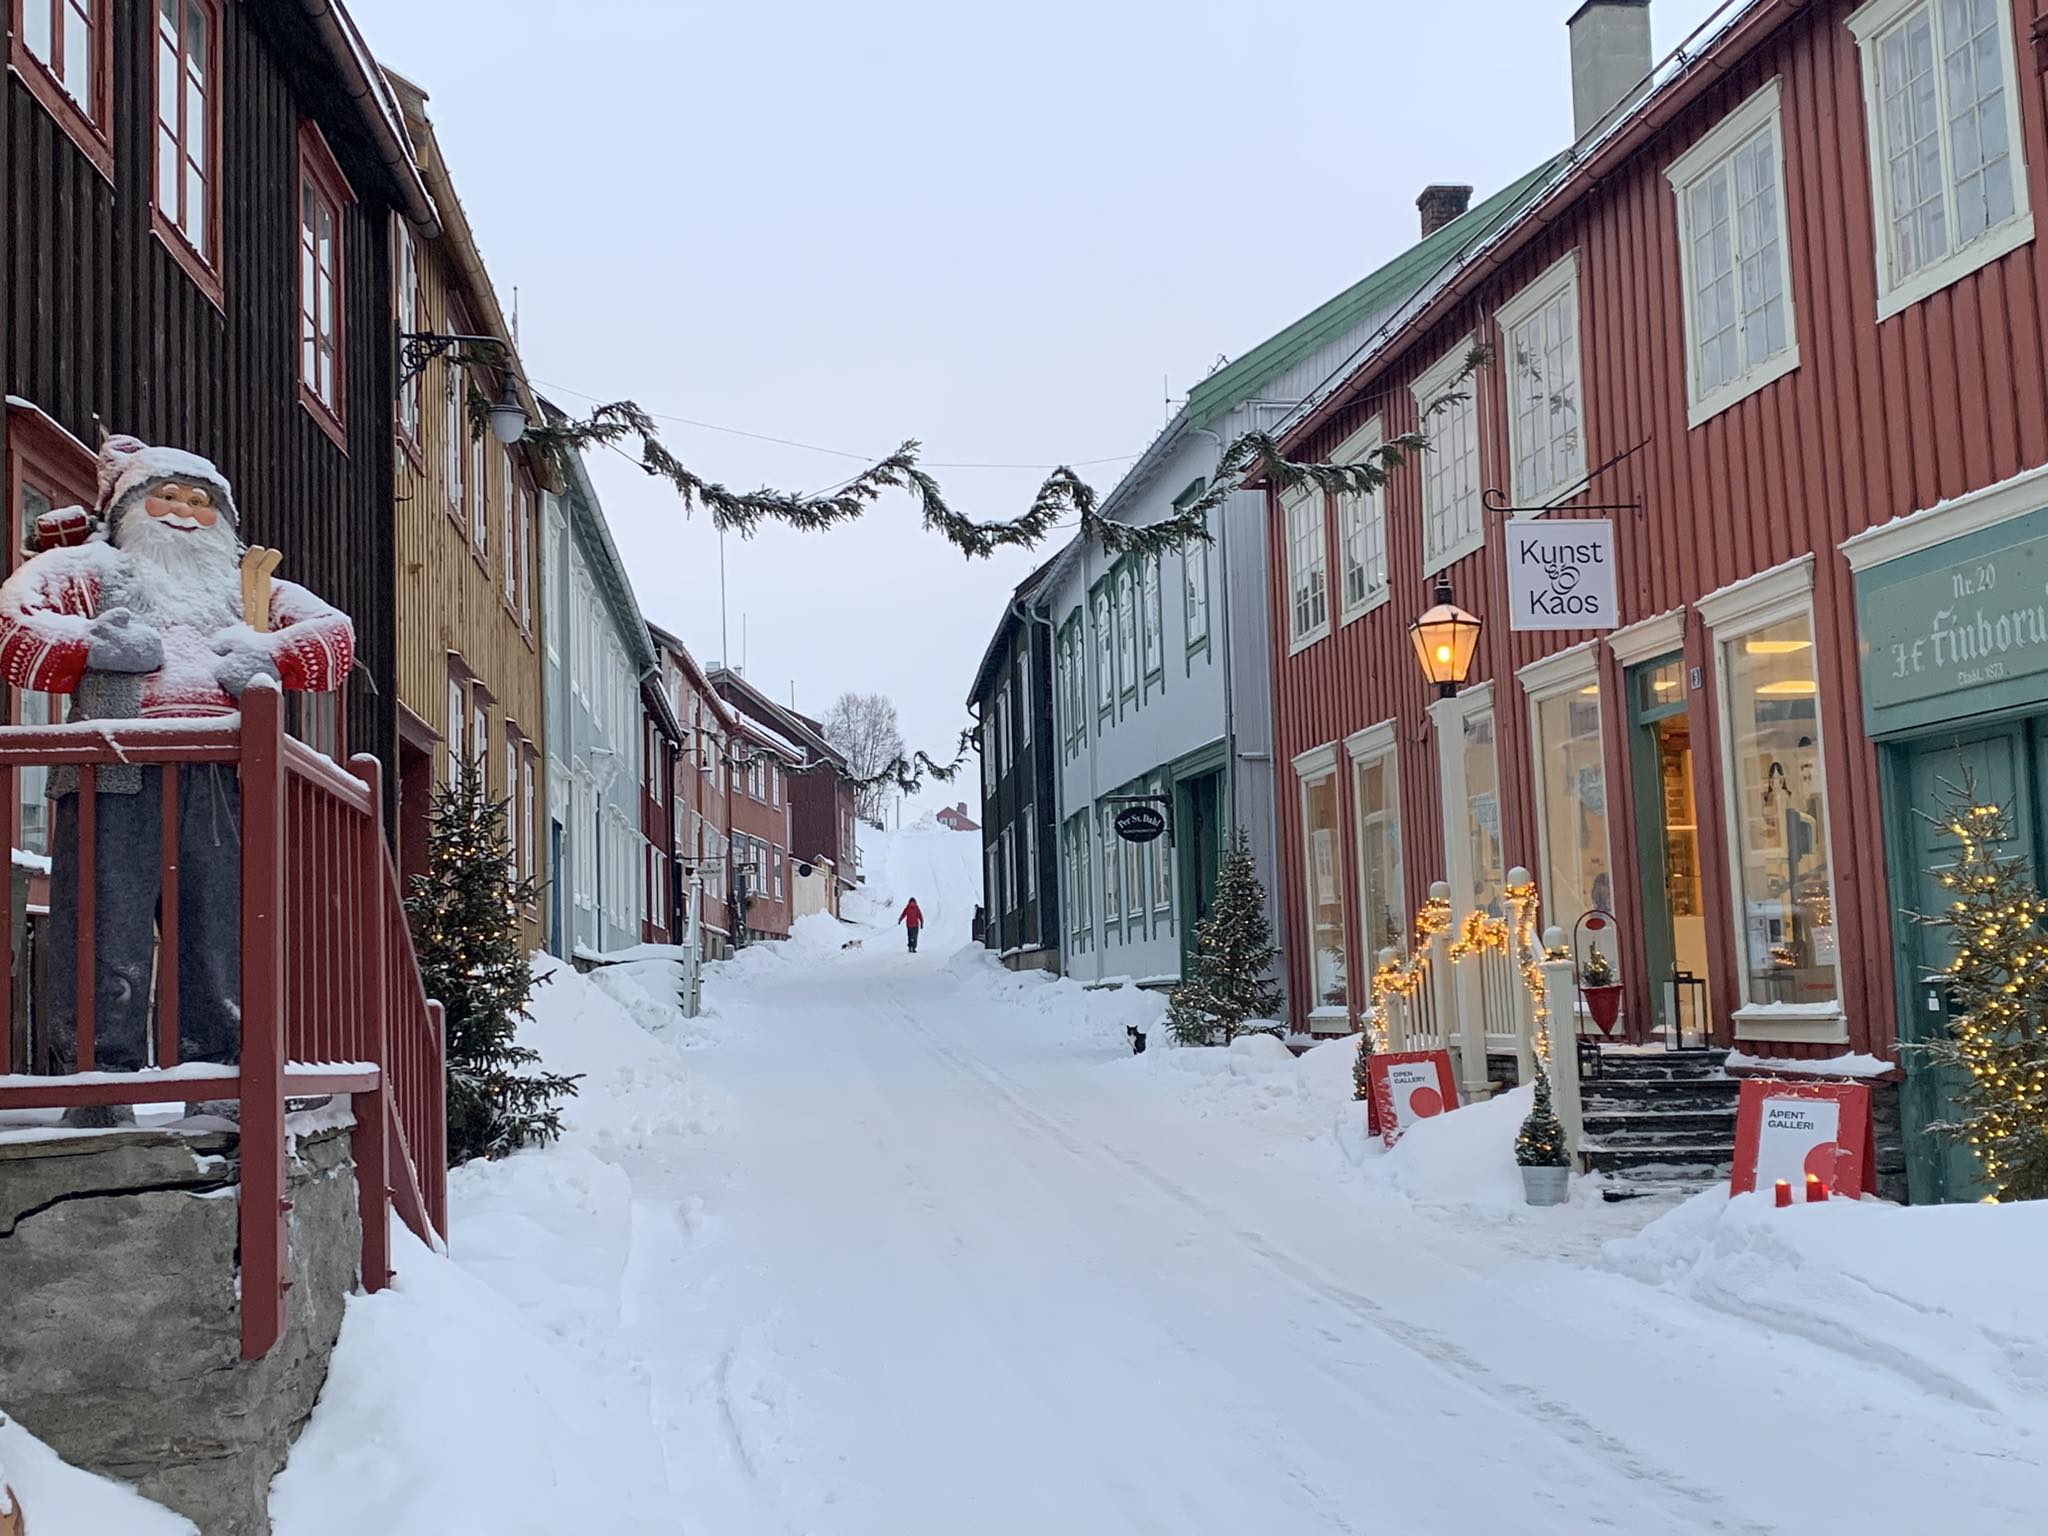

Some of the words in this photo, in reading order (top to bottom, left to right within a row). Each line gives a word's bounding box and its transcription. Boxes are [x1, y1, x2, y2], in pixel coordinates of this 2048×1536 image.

[1520, 539, 1604, 565] Kunst
[1952, 573, 1975, 599] Nr.
[1976, 562, 1997, 592] 20
[1530, 589, 1600, 615] Kaos
[1930, 602, 2048, 668] Finboru
[1117, 817, 1131, 829] Per
[1143, 813, 1162, 828] Dahl
[1394, 1076, 1425, 1084] GALLERY
[1768, 1119, 1814, 1130] GALLERI
[1769, 1109, 1805, 1119] ÅPENT
